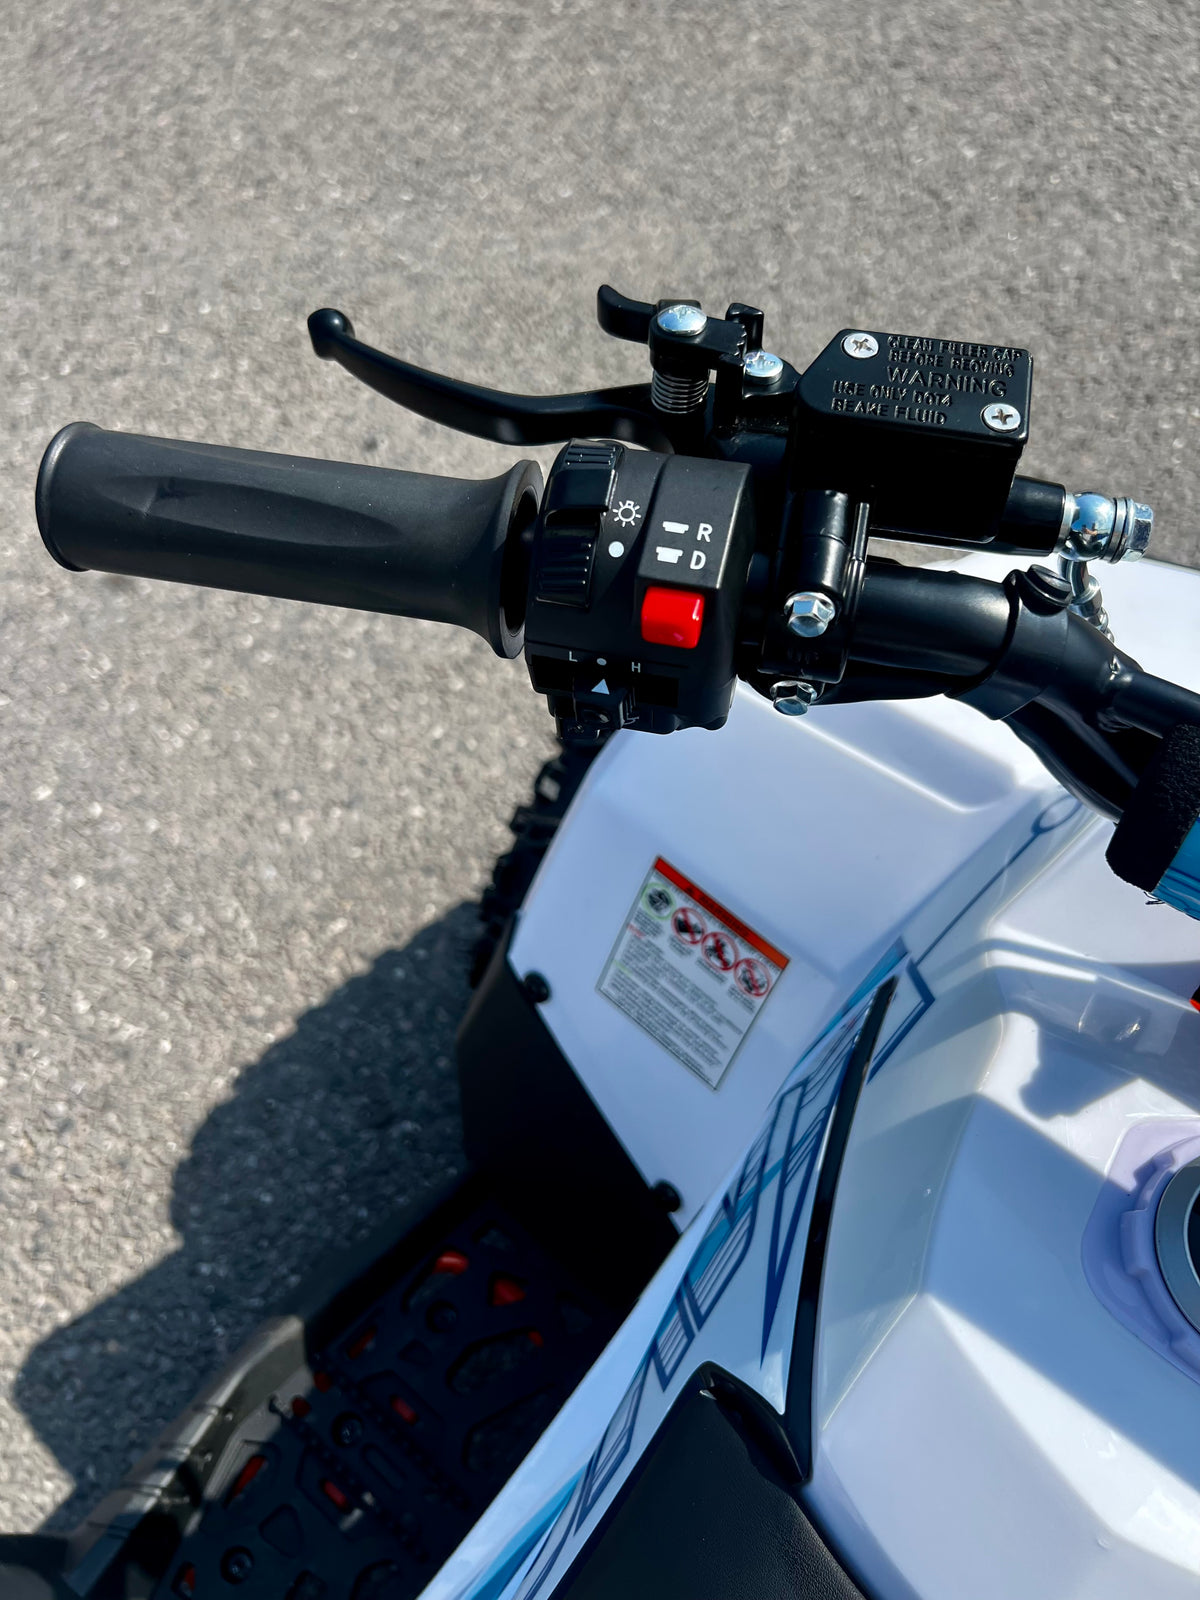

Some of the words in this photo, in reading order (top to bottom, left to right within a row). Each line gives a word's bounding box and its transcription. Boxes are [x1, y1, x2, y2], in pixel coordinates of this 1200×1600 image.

[887, 335, 933, 352] CLEAN
[939, 341, 989, 358] FILLER
[992, 347, 1022, 361] CAP
[888, 349, 944, 368] BEFORE
[887, 366, 1008, 398] WARNING
[832, 379, 866, 396] USE
[869, 384, 907, 402] ONLY
[912, 389, 953, 408] DOT4
[894, 405, 948, 425] FLUID
[696, 522, 713, 543] R
[690, 550, 706, 570] D
[568, 651, 578, 662] L
[631, 662, 641, 673] H
